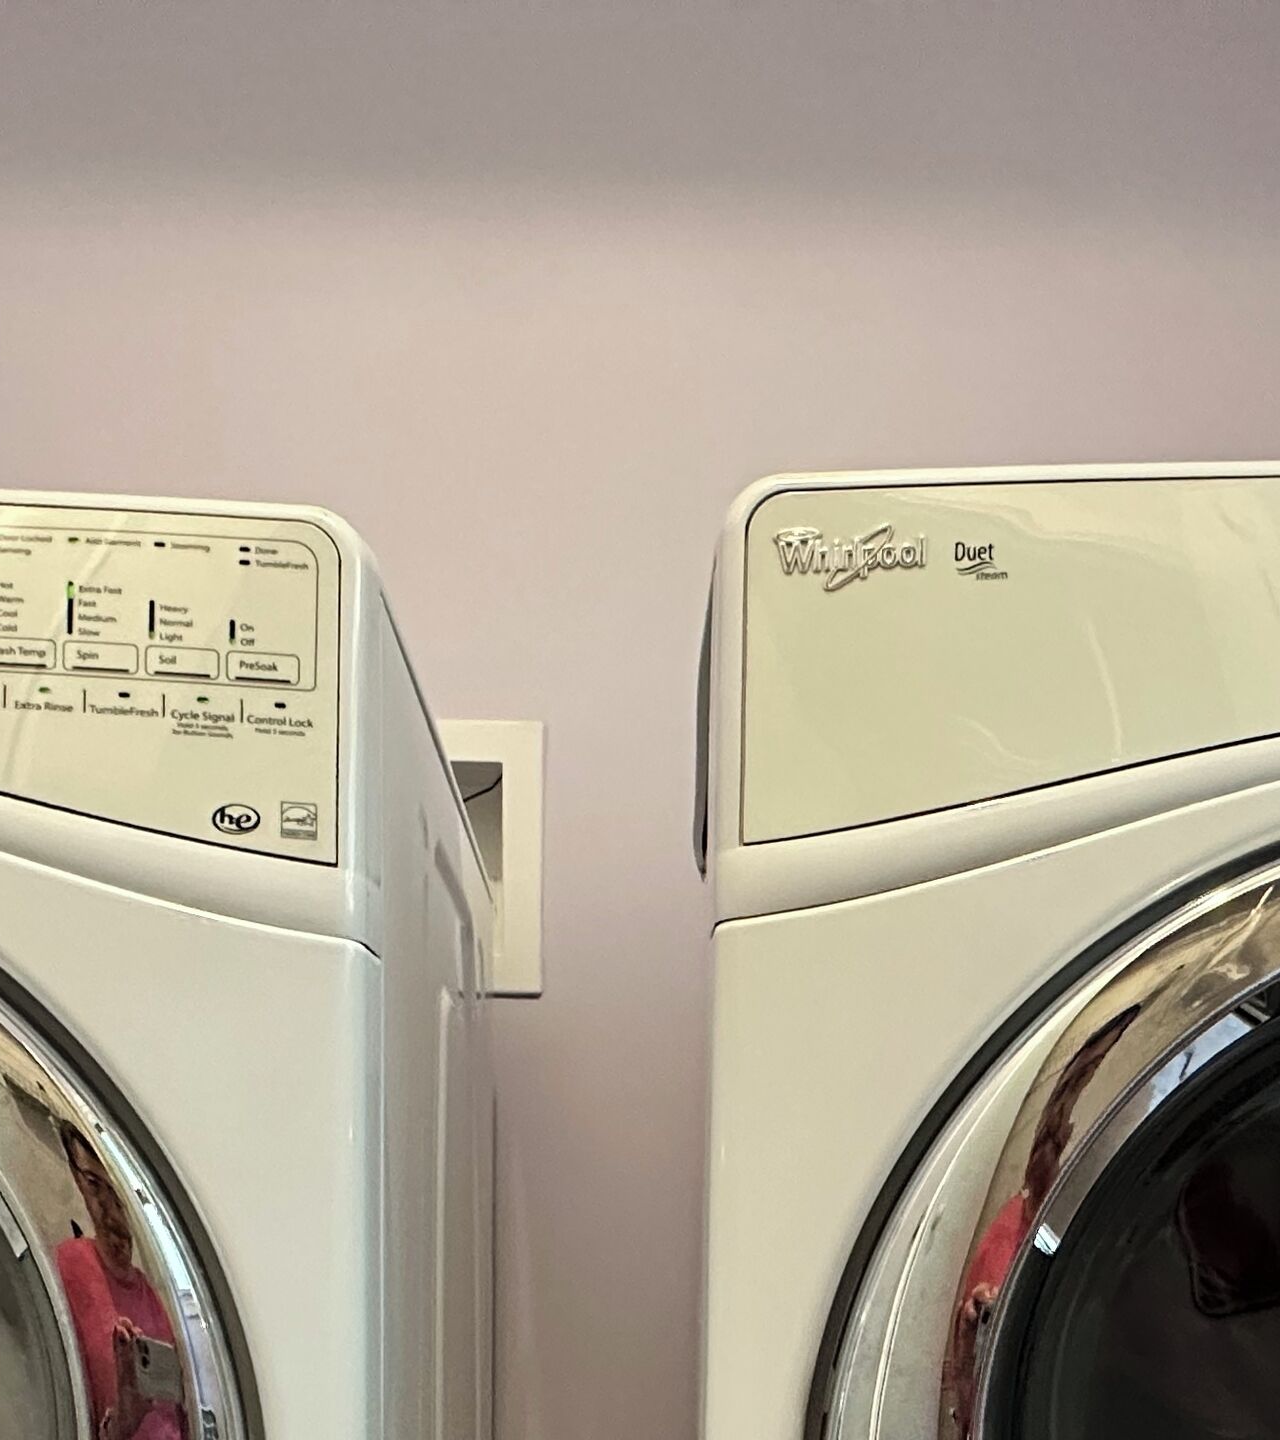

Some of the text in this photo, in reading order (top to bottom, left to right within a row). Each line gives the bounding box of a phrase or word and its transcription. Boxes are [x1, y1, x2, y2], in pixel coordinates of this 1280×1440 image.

[953, 541, 995, 562] Duet
[773, 523, 928, 592] Whirlpool
[78, 599, 96, 607] Fast
[159, 603, 188, 614] Heavy
[78, 613, 117, 623] Medium
[159, 618, 193, 628] Normal
[78, 627, 100, 637] Slow
[240, 623, 255, 632] On
[159, 632, 183, 643] Light
[240, 637, 255, 647] Off
[18, 646, 46, 658] Temp
[76, 650, 99, 661] Spin
[158, 655, 177, 665] Soil
[239, 660, 279, 672] PreSoak
[14, 700, 73, 713] Extra Rinse
[89, 704, 159, 718] TumbleFresh
[171, 708, 235, 723] Cycle Signal
[247, 714, 314, 729] Control Lock
[220, 805, 252, 830] he
